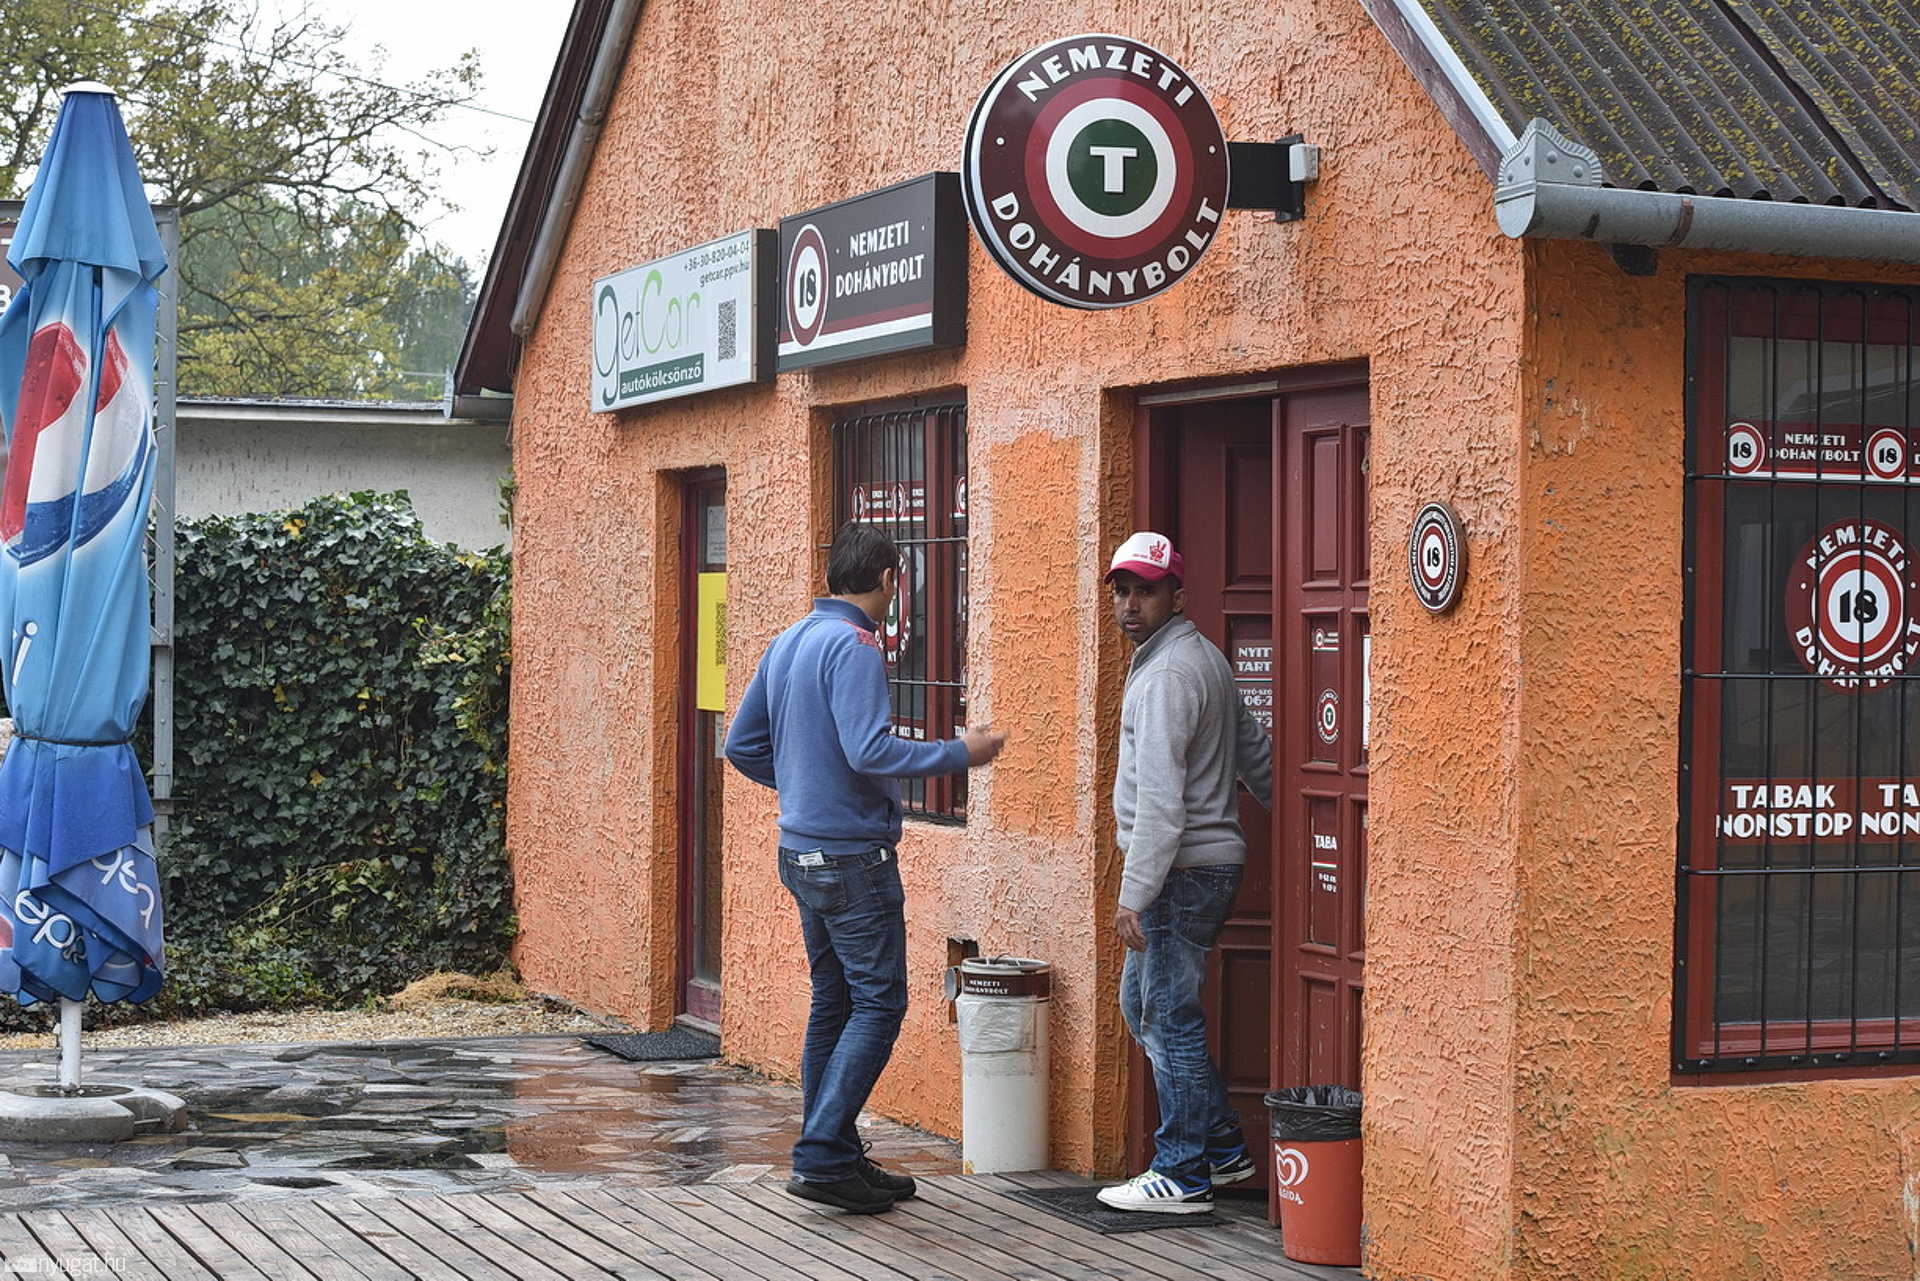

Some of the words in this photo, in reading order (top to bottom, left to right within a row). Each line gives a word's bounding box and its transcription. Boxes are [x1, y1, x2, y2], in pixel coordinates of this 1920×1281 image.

[1017, 45, 1195, 107] NEMZETI
[1089, 145, 1138, 194] T
[850, 220, 910, 259] NEMZETI
[991, 192, 1220, 296] DOHÁNYBOLT
[798, 268, 817, 308] 18
[835, 254, 925, 298] DOHÁNYBOLT
[621, 361, 701, 395] autókölcsönző
[1732, 441, 1752, 459] 18
[1878, 447, 1898, 464] 18
[1426, 546, 1441, 568] 18
[1839, 589, 1879, 624] 18
[1730, 784, 1836, 809] TABAK
[1715, 812, 1854, 838] NONSTOP
